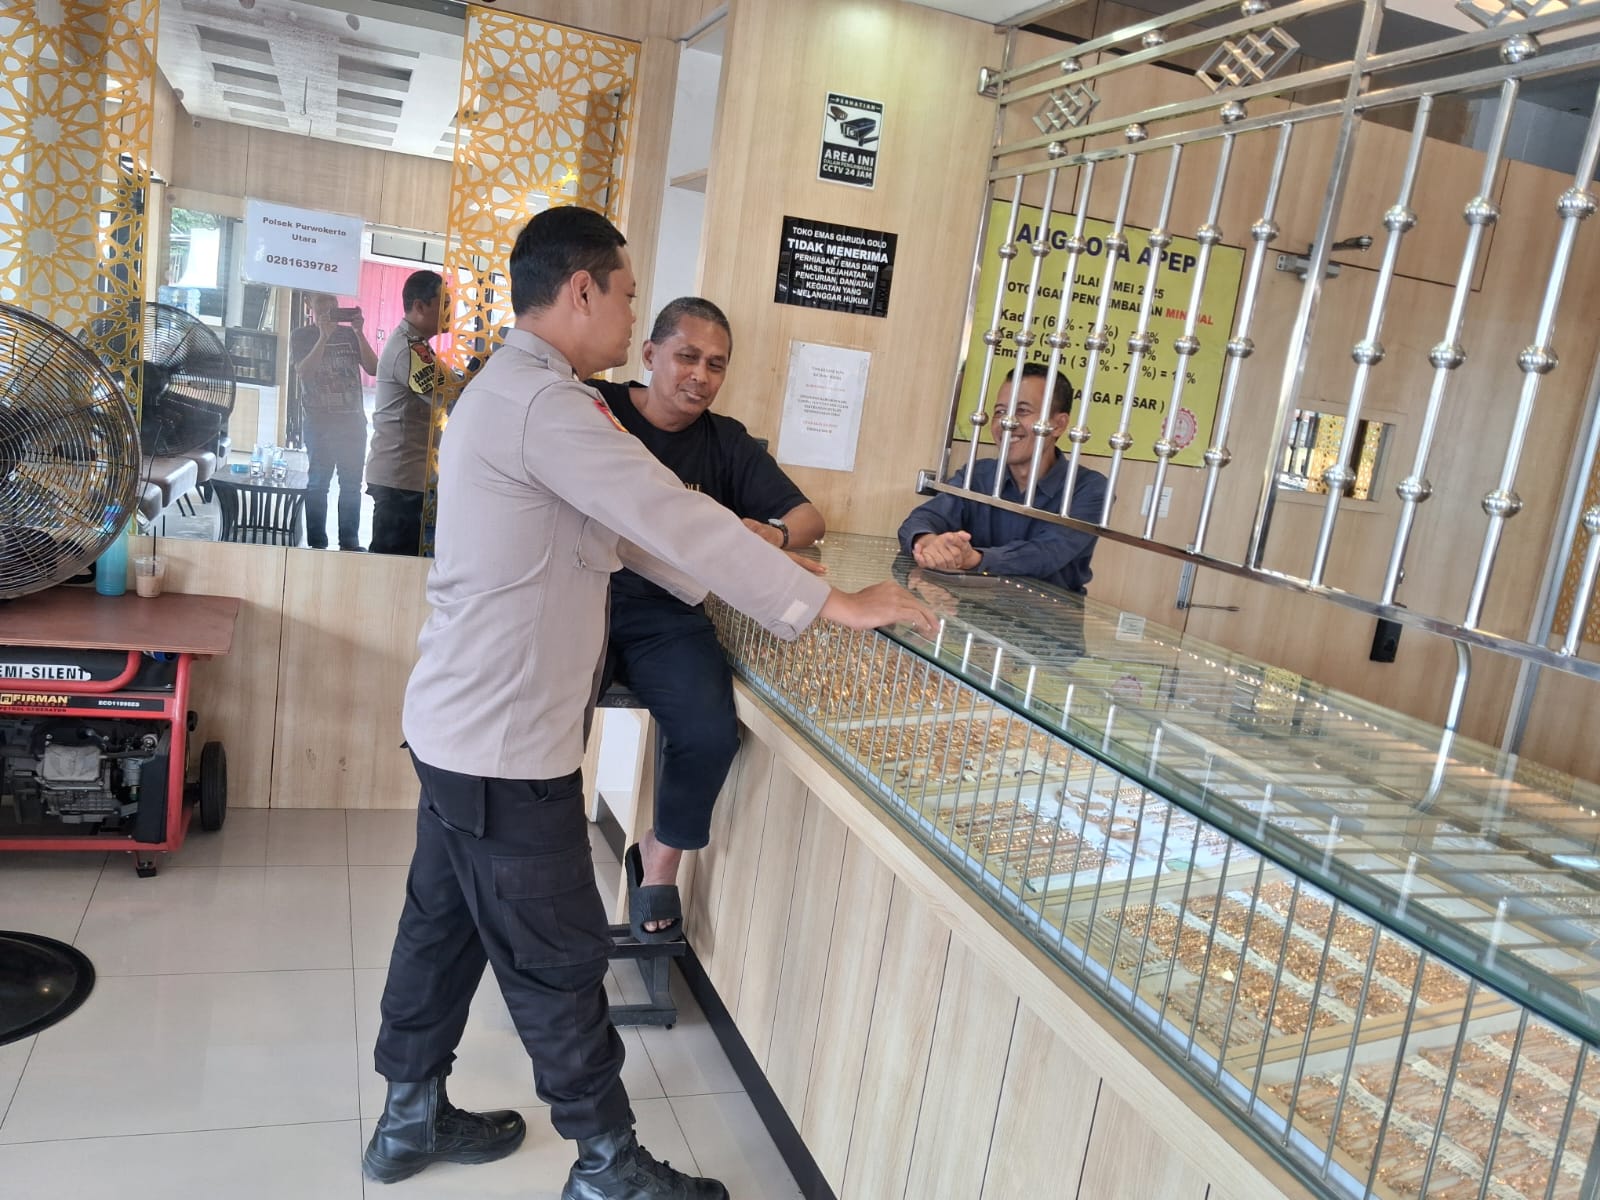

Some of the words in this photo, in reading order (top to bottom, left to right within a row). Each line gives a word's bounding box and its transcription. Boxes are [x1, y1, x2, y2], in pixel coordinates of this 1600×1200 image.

[824, 149, 855, 163] AREA
[857, 155, 874, 167] INI
[822, 164, 844, 174] CCTV
[845, 168, 856, 177] 24
[856, 170, 873, 179] JAM
[262, 216, 293, 228] Polsek
[295, 222, 347, 237] Purwokerto
[291, 233, 317, 244] Utara
[792, 226, 813, 236] TOKO
[814, 230, 835, 240] EMAS
[835, 234, 866, 245] GARUDA
[787, 238, 824, 253] TIDAK
[826, 244, 889, 264] MENERIMA
[266, 254, 338, 273] 0281639782
[795, 253, 835, 266] PERHIASAN
[840, 261, 860, 270] EMAS
[861, 264, 879, 273] DARI
[803, 263, 824, 273] HASIL
[825, 266, 868, 280] KEJAHATAN,
[795, 271, 838, 285] PENCURIAN,
[806, 281, 840, 293] KEGIATAN
[842, 286, 862, 296] YANG
[1112, 281, 1135, 294] MEI
[796, 288, 844, 301] MELANGGAR
[842, 295, 869, 305] HUKUM
[12, 694, 68, 704] FIRMAN
